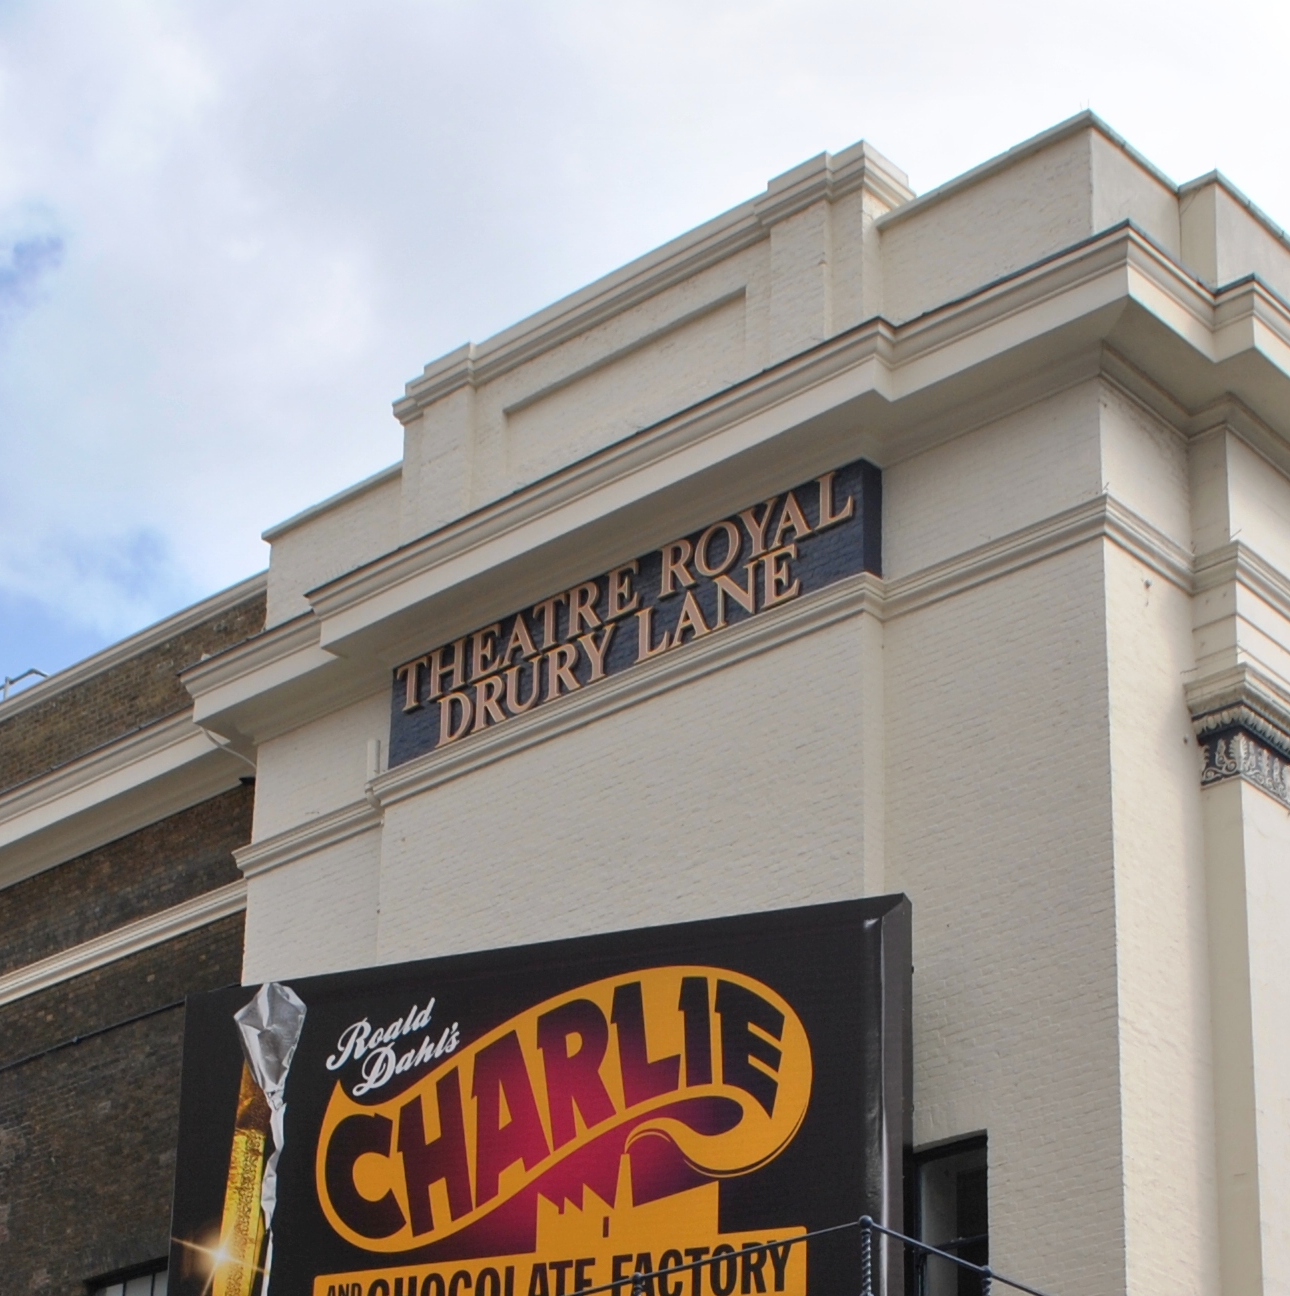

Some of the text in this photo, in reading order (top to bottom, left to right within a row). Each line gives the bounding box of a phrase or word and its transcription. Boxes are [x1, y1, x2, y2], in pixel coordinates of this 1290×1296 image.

[396, 470, 856, 714] THEATRE ROYAL
[435, 542, 802, 749] DRURY LANE
[323, 976, 787, 1241] CHARLIE
[324, 995, 438, 1073] Roald
[351, 1020, 461, 1097] Dahl's
